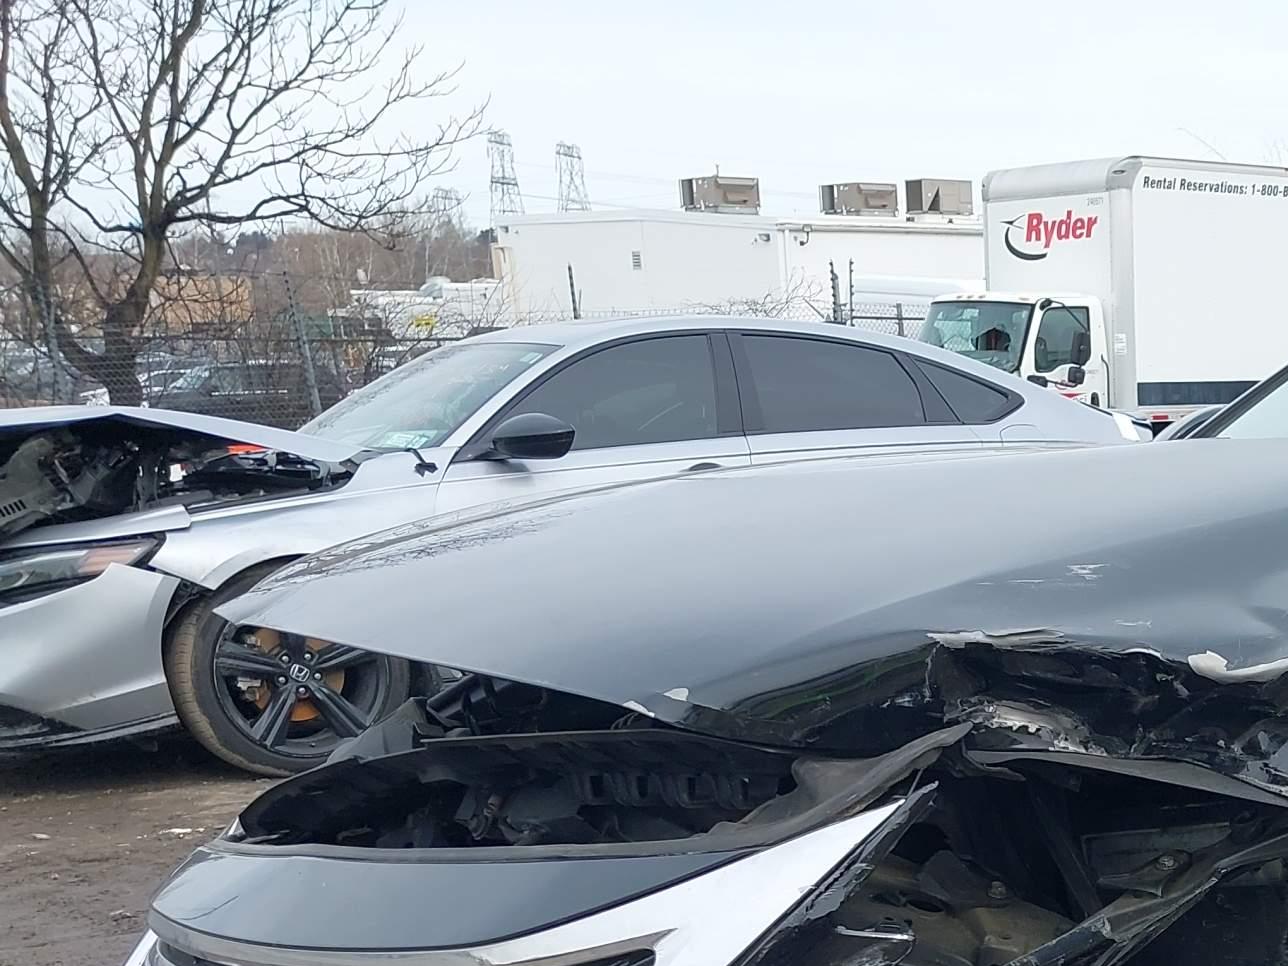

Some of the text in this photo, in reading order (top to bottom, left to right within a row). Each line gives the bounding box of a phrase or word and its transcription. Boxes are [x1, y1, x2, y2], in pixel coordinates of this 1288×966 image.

[1143, 176, 1176, 190] Rental
[1179, 178, 1248, 195] Reservations:
[1025, 210, 1098, 249] Ryder
